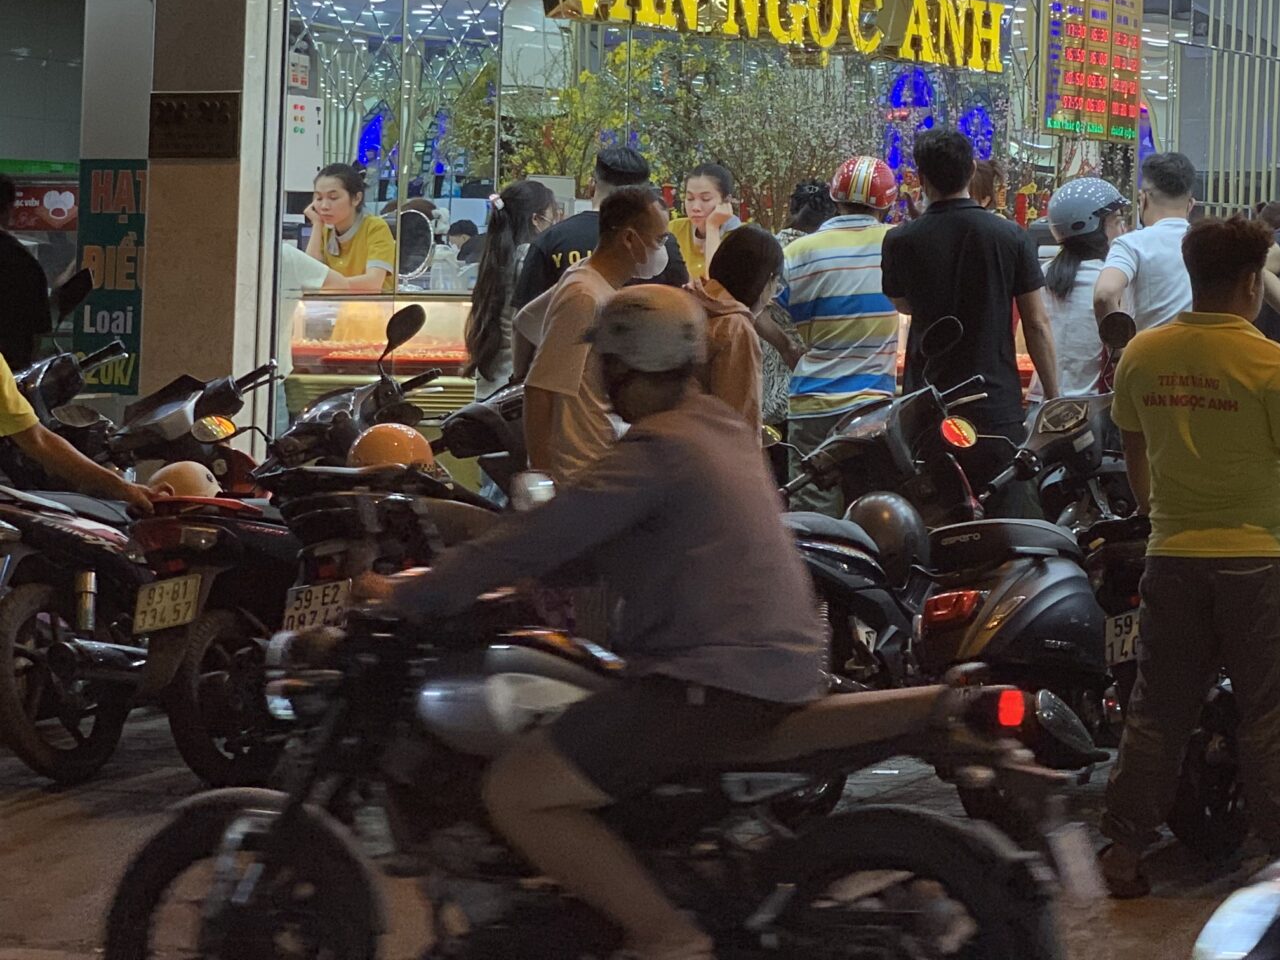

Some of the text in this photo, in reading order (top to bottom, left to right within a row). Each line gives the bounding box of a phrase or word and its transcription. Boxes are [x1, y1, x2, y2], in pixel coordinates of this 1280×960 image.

[83, 304, 134, 340] Loại
[1208, 398, 1239, 412] ANH
[294, 584, 340, 611] 59-E2
